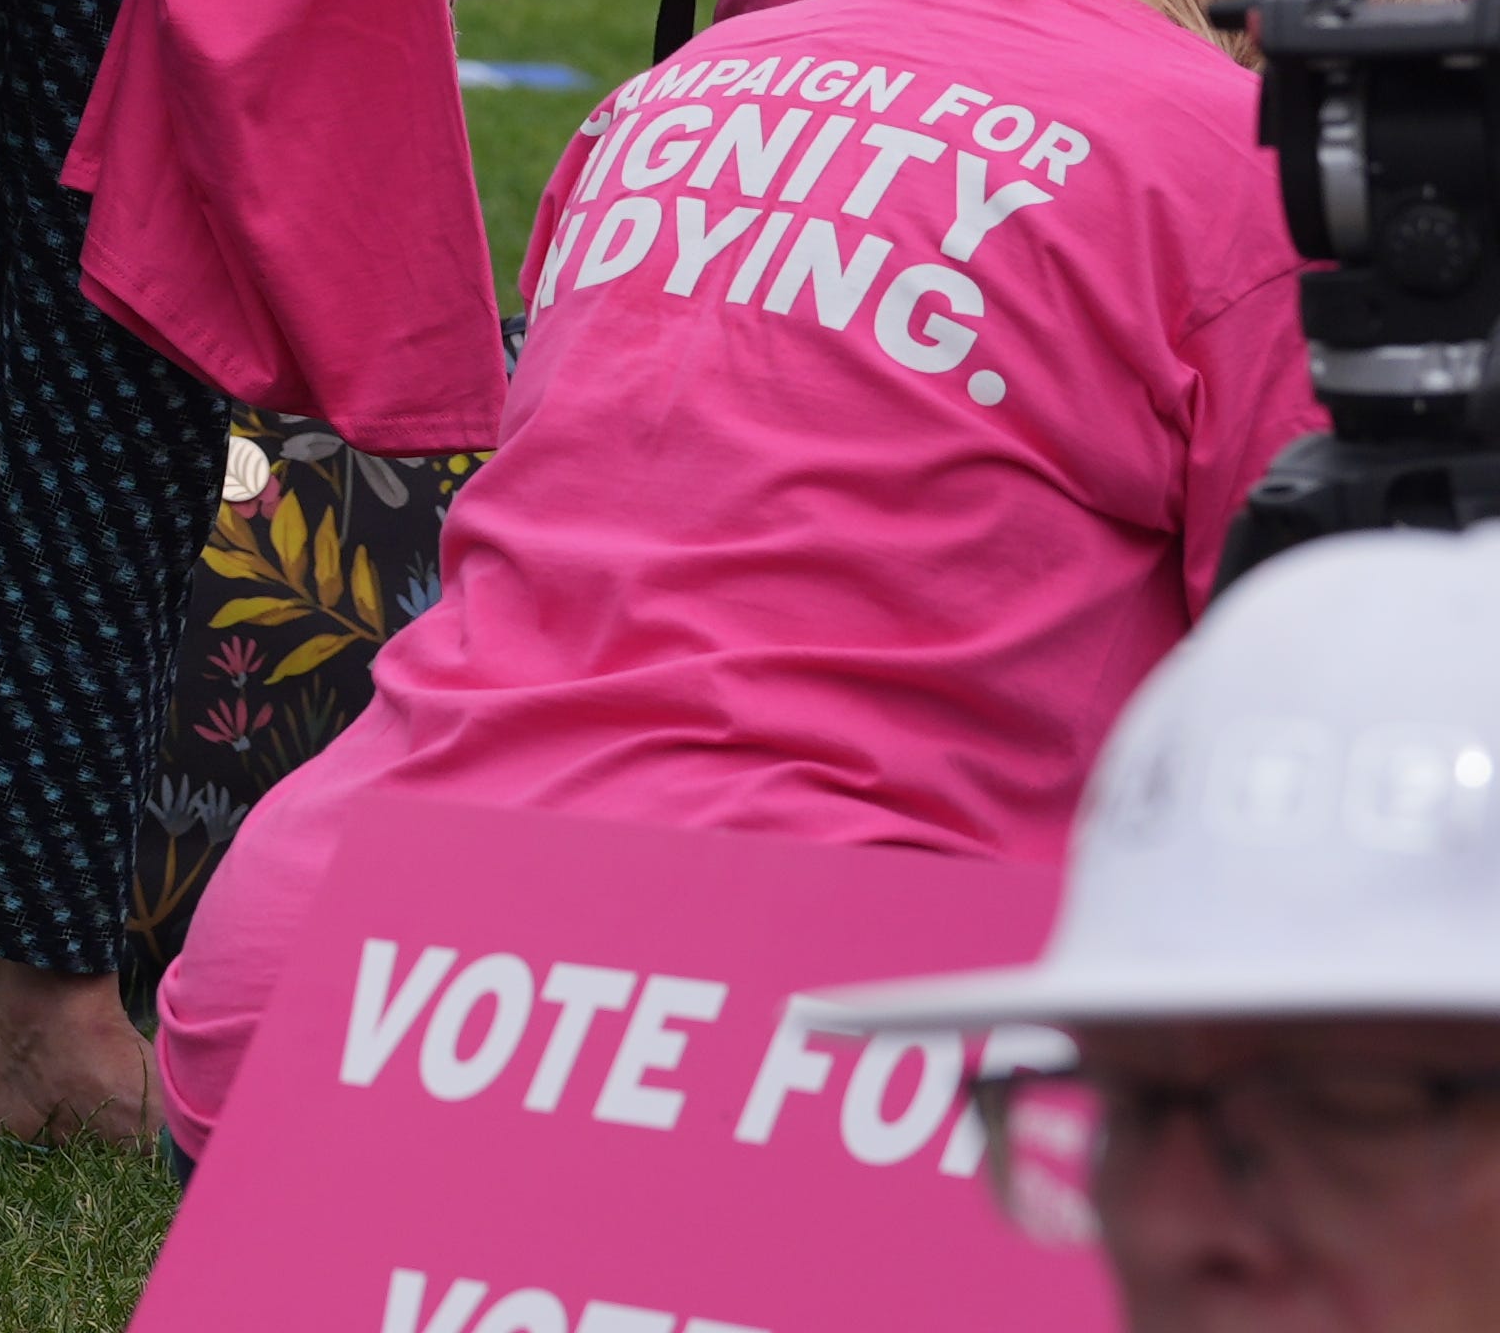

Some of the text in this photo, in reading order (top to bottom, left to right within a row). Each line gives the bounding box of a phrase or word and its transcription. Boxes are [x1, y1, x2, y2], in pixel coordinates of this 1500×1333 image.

[572, 103, 1053, 263] IGNITY
[919, 83, 1091, 186] FOR
[573, 195, 1007, 407] DYING.
[338, 937, 730, 1132] VOTE
